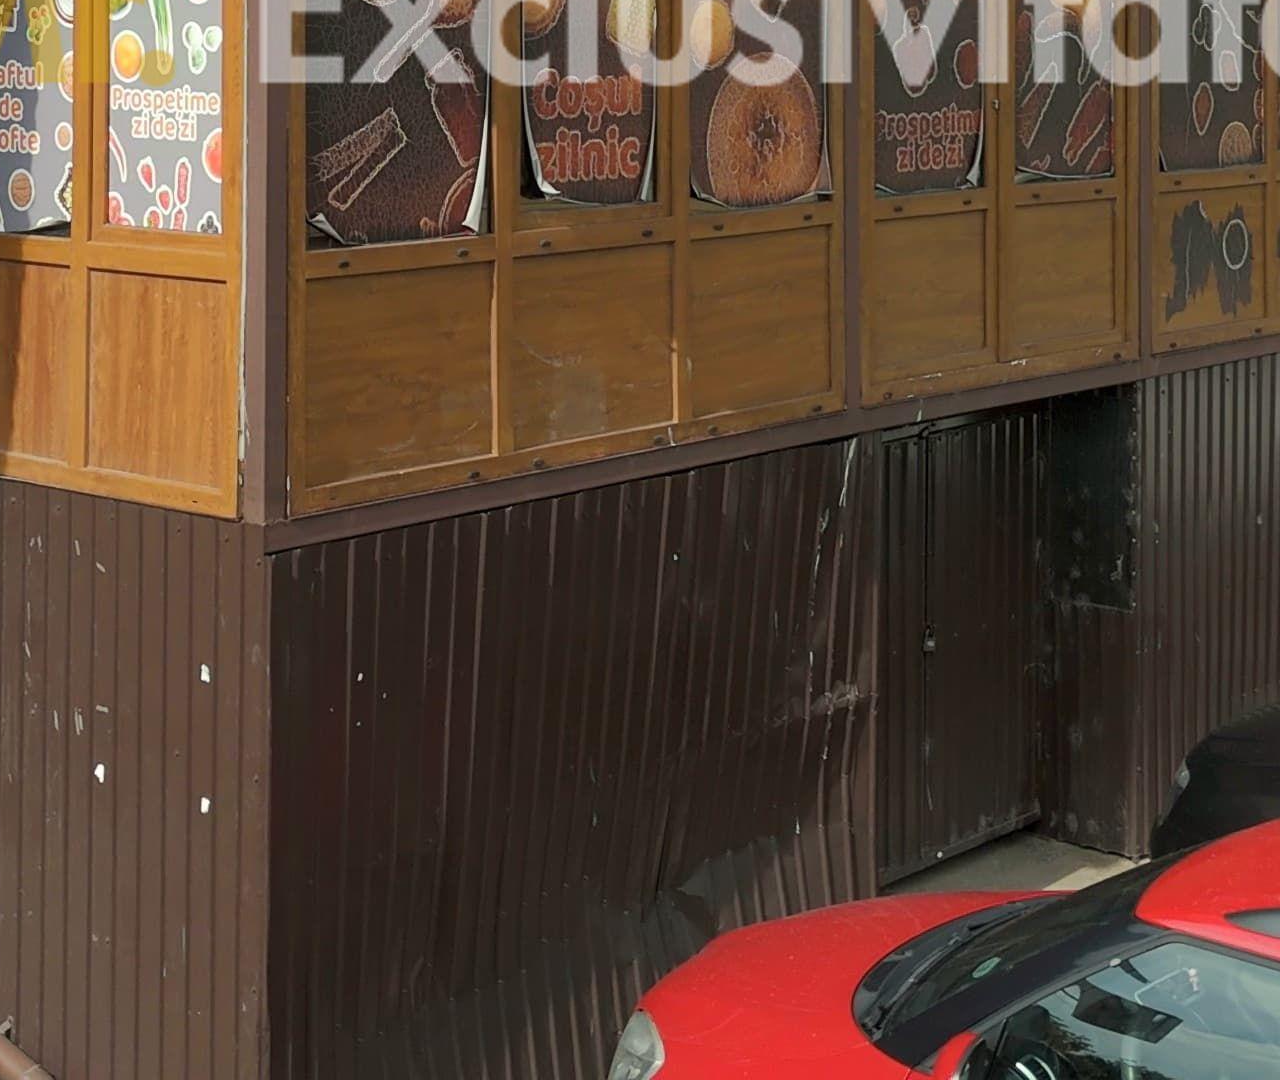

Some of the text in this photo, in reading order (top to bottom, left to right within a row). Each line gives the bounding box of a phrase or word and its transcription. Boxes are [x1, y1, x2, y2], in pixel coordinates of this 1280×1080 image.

[110, 84, 220, 120] Prospețime
[532, 64, 642, 132] Coșul
[132, 110, 197, 142] zi de zi
[535, 124, 640, 183] zilnic
[917, 140, 945, 170] de
